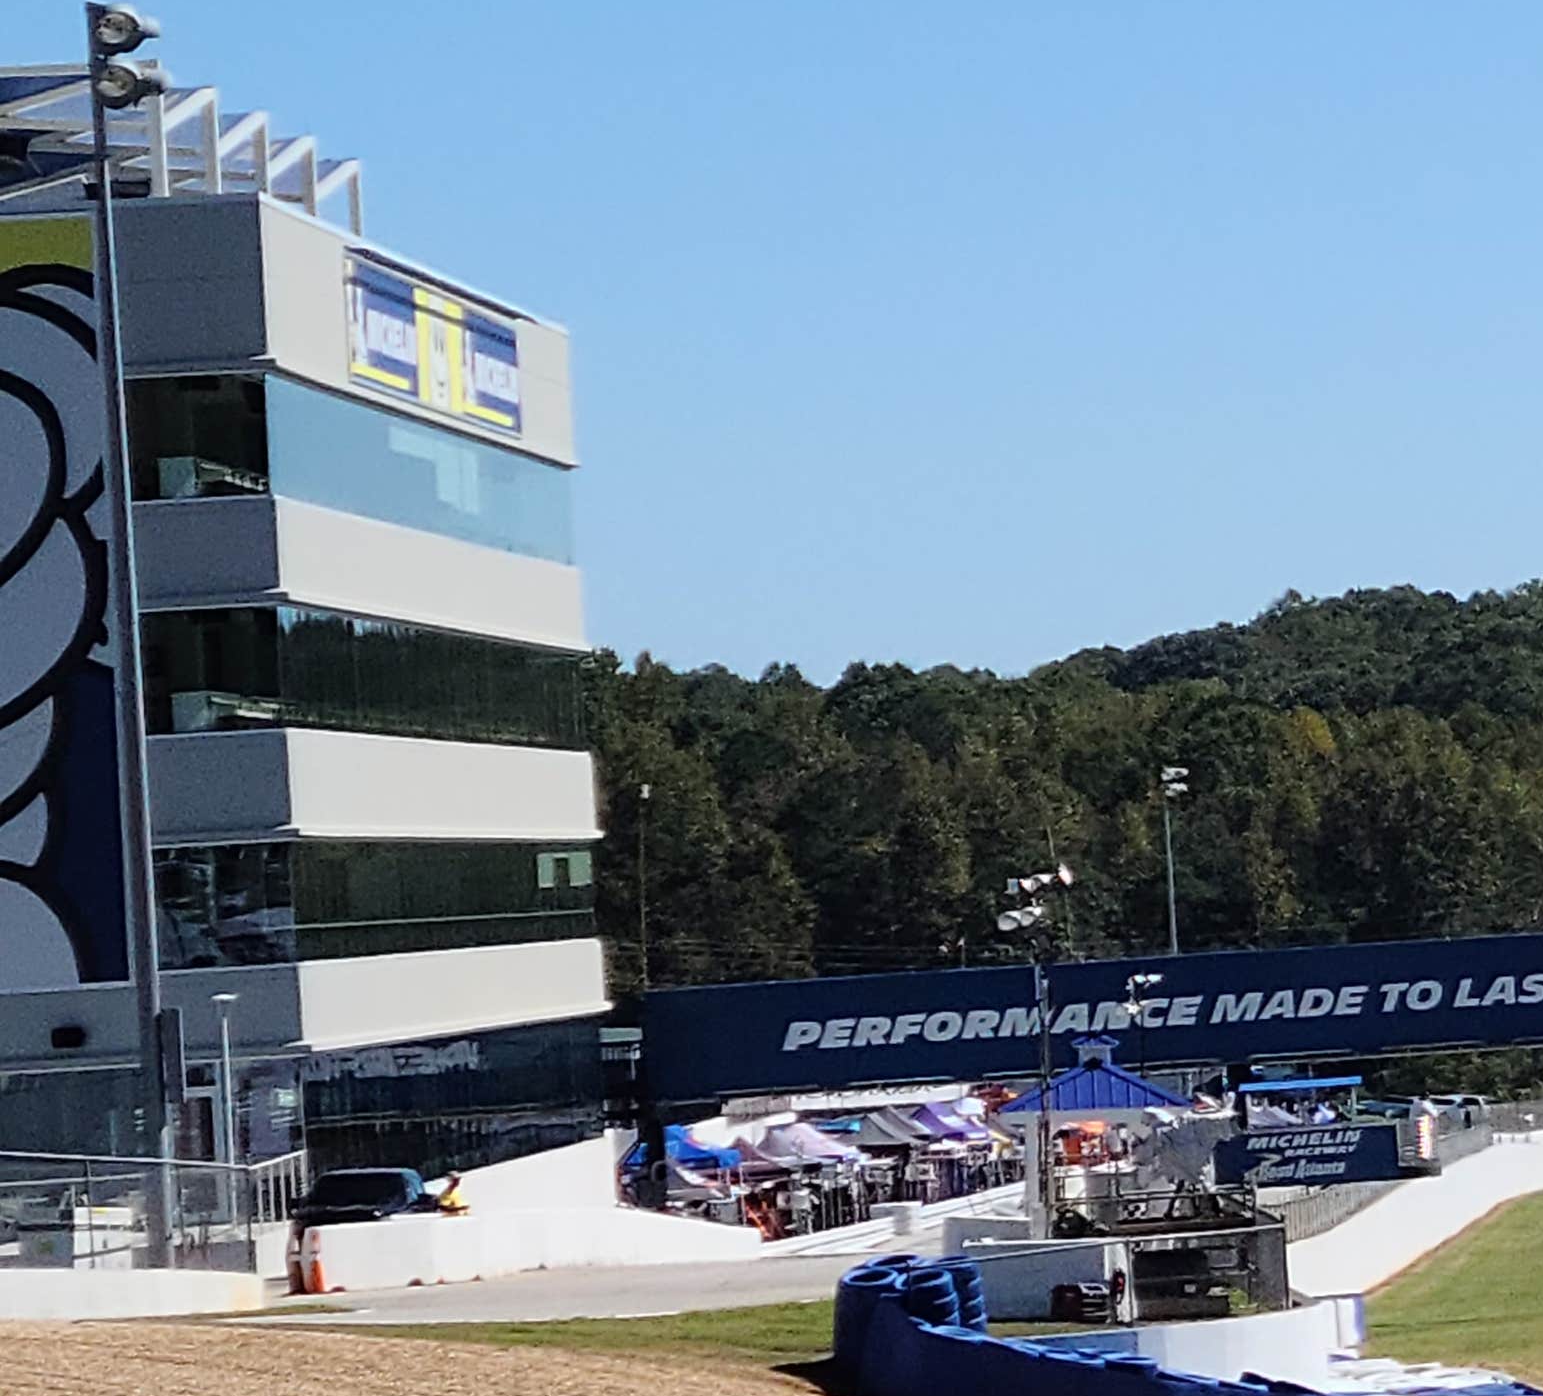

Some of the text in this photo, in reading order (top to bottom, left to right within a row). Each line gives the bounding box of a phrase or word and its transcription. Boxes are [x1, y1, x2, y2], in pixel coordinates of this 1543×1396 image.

[782, 994, 1204, 1052] PERFORMANCE
[1209, 985, 1370, 1025] MADE
[1378, 979, 1444, 1014] TO
[1247, 1129, 1362, 1151] MICHELIN
